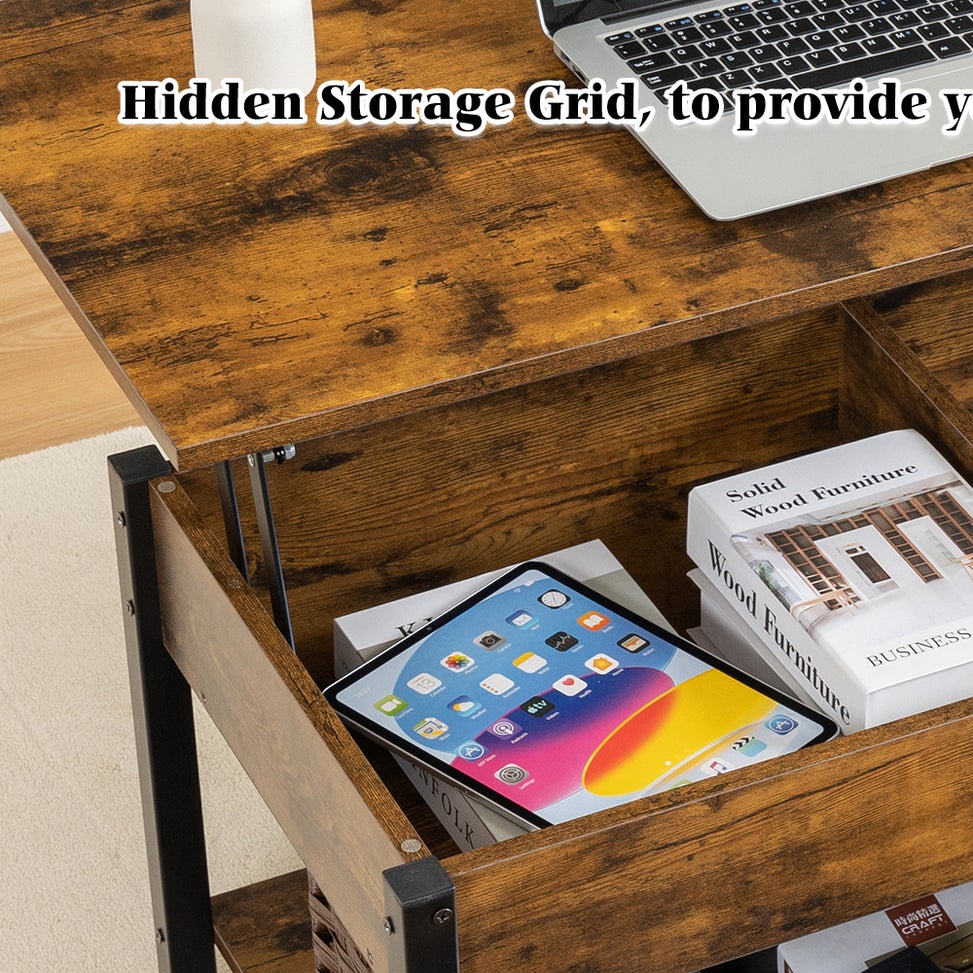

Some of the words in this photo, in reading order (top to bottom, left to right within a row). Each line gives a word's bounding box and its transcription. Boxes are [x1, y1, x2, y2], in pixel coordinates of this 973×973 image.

[725, 478, 787, 504] Solid
[740, 494, 808, 522] Wood
[810, 463, 919, 501] Furniture
[707, 538, 759, 619] Wood
[762, 604, 852, 727] Furniture
[866, 626, 972, 669] BUSINESS
[535, 700, 548, 711] tv
[901, 913, 943, 935] CRAFT
